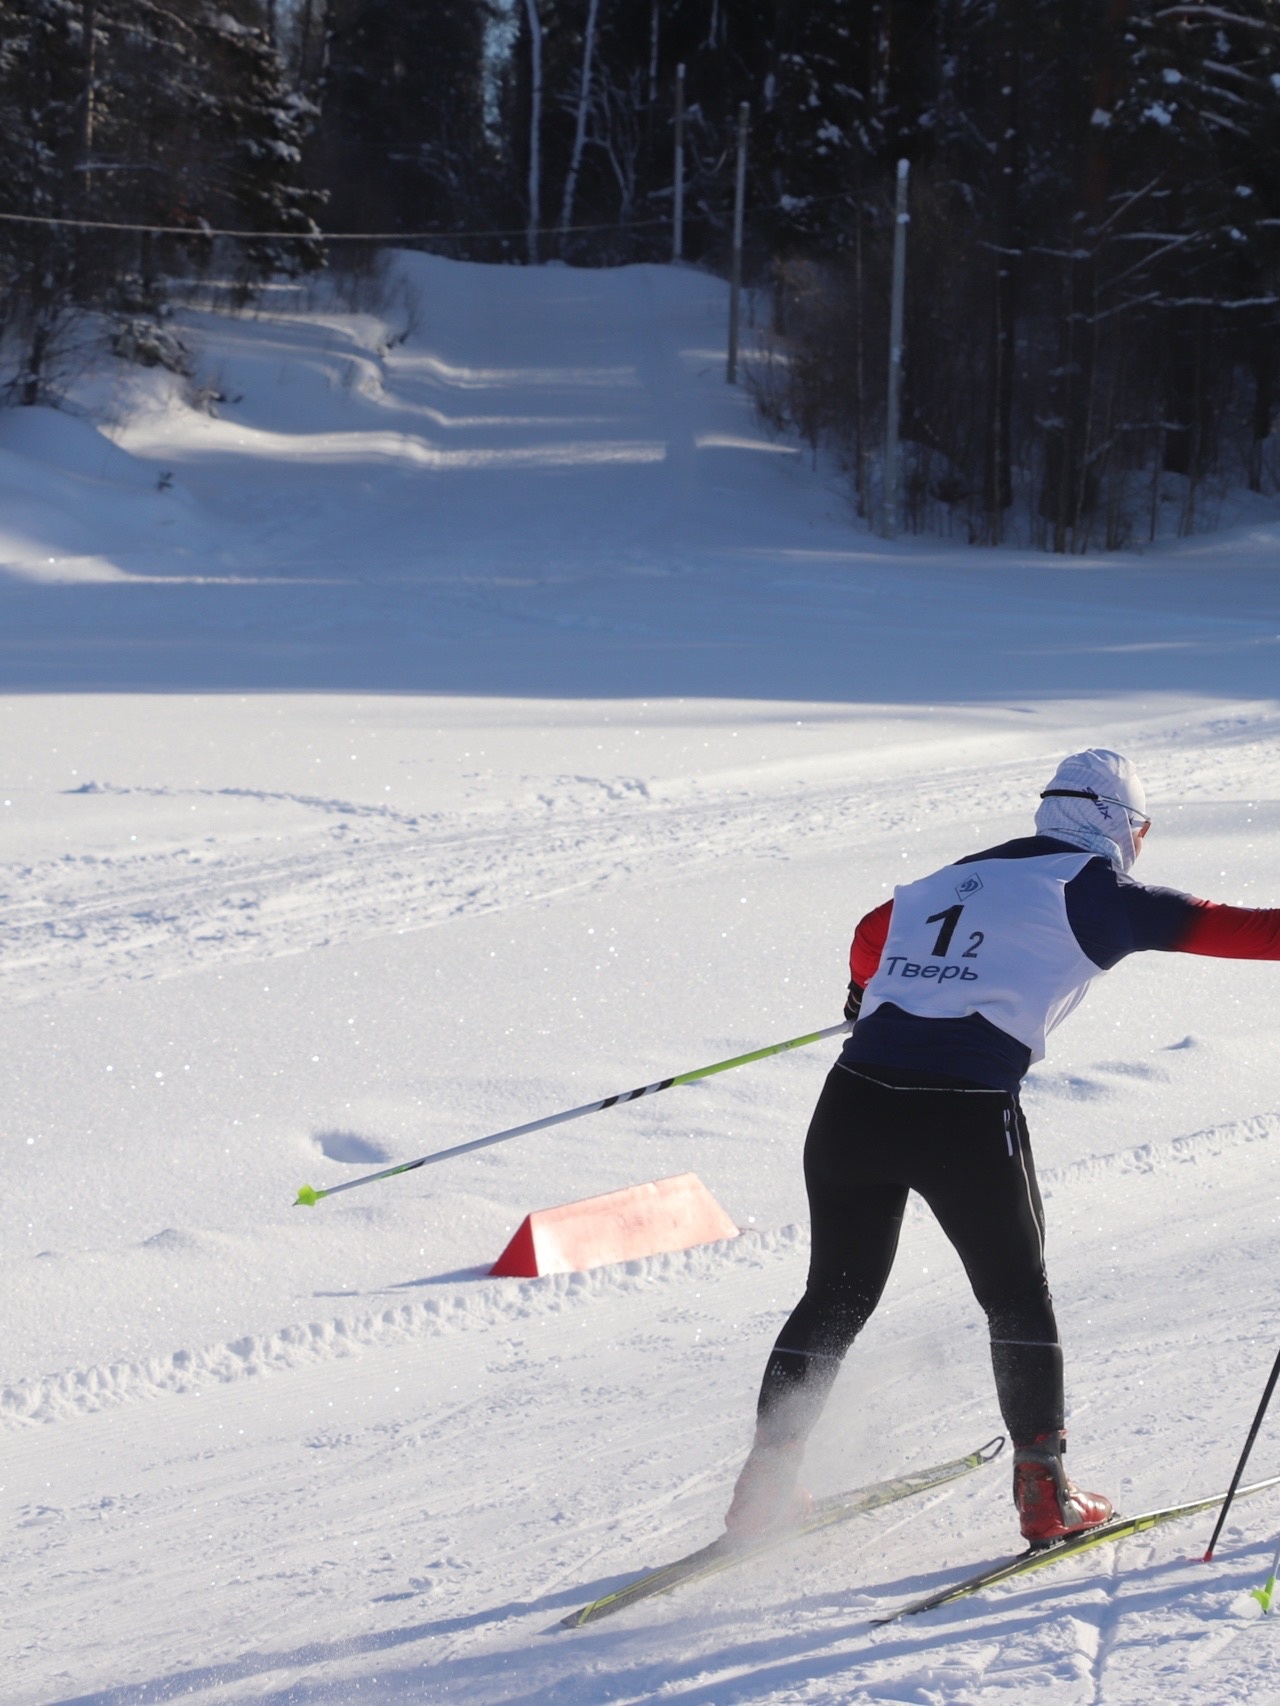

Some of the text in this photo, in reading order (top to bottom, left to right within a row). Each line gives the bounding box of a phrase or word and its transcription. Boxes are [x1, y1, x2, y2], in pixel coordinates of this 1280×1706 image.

[924, 904, 984, 958] 1 2
[885, 956, 979, 984] Тверь
